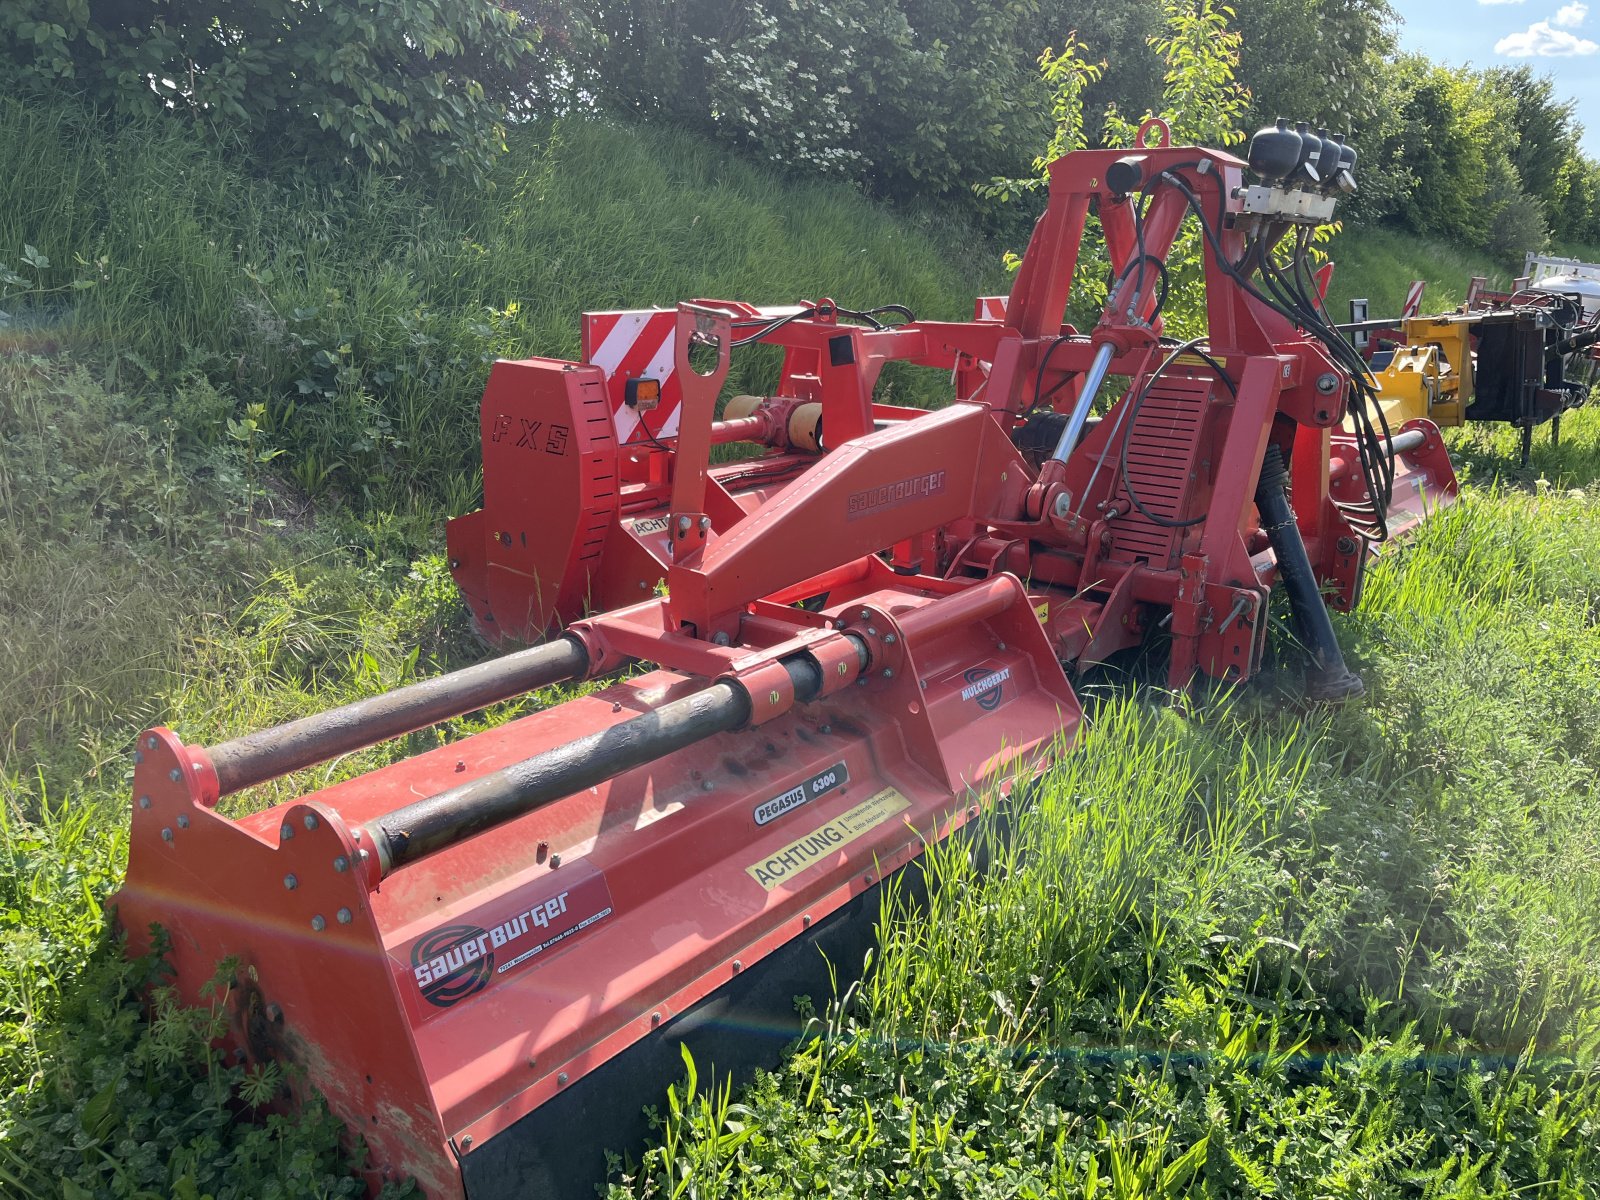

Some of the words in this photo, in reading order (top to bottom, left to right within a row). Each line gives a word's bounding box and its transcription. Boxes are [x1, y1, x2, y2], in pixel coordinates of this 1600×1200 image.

[758, 788, 804, 821] PEGASUS
[812, 771, 837, 793] 6300
[754, 826, 844, 886] ACHTUNG
